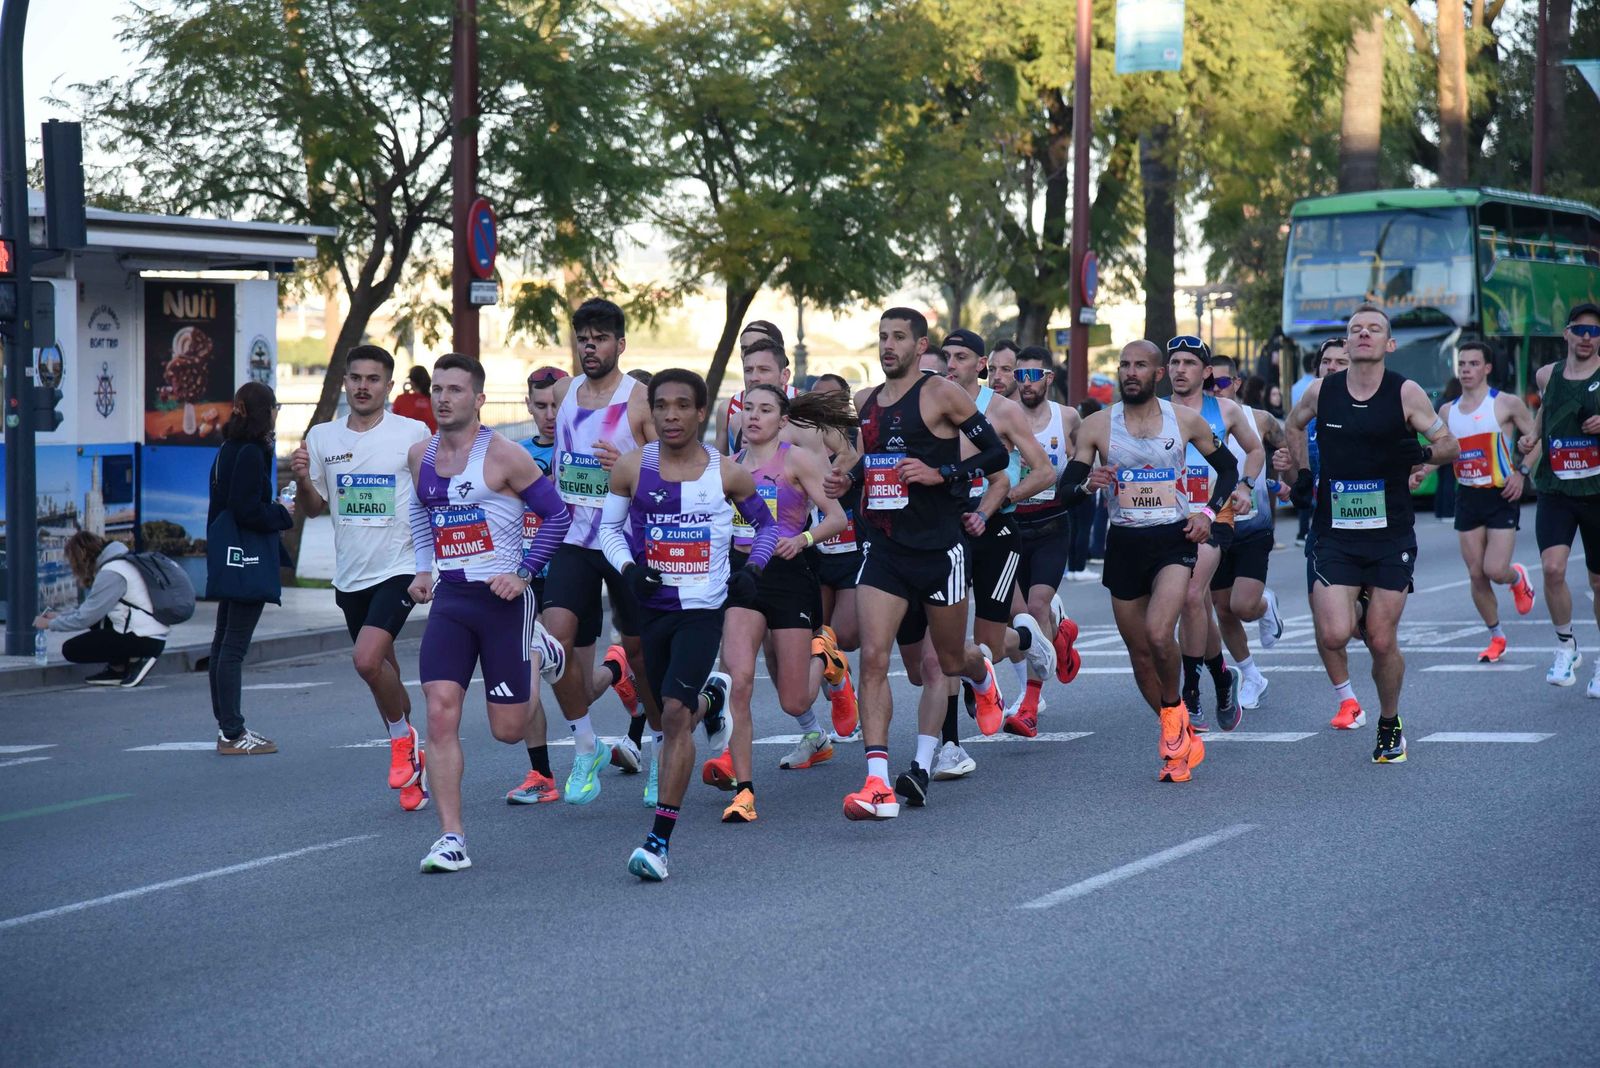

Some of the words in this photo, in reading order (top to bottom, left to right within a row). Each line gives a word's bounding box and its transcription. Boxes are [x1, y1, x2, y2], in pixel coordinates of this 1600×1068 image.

[872, 457, 899, 465] ZURICH
[1563, 460, 1588, 469] KUBA
[576, 472, 588, 480] 567
[1137, 471, 1169, 479] ZURICH
[356, 477, 389, 485] ZURICH
[560, 480, 593, 494] STEVEN
[869, 484, 902, 498] LORENÇ
[1347, 482, 1378, 491] ZURICH
[359, 492, 373, 500] 579
[1350, 497, 1363, 505] 471
[1131, 496, 1163, 507] YAHIA
[346, 503, 387, 514] ALFARO
[1340, 506, 1377, 518] RAMON
[447, 513, 478, 524] ZURICH
[452, 531, 466, 541] 670
[667, 530, 703, 539] ZURICH
[441, 539, 486, 557] MAXIME
[669, 547, 685, 557] 698
[647, 559, 709, 573] NASSURDINE
